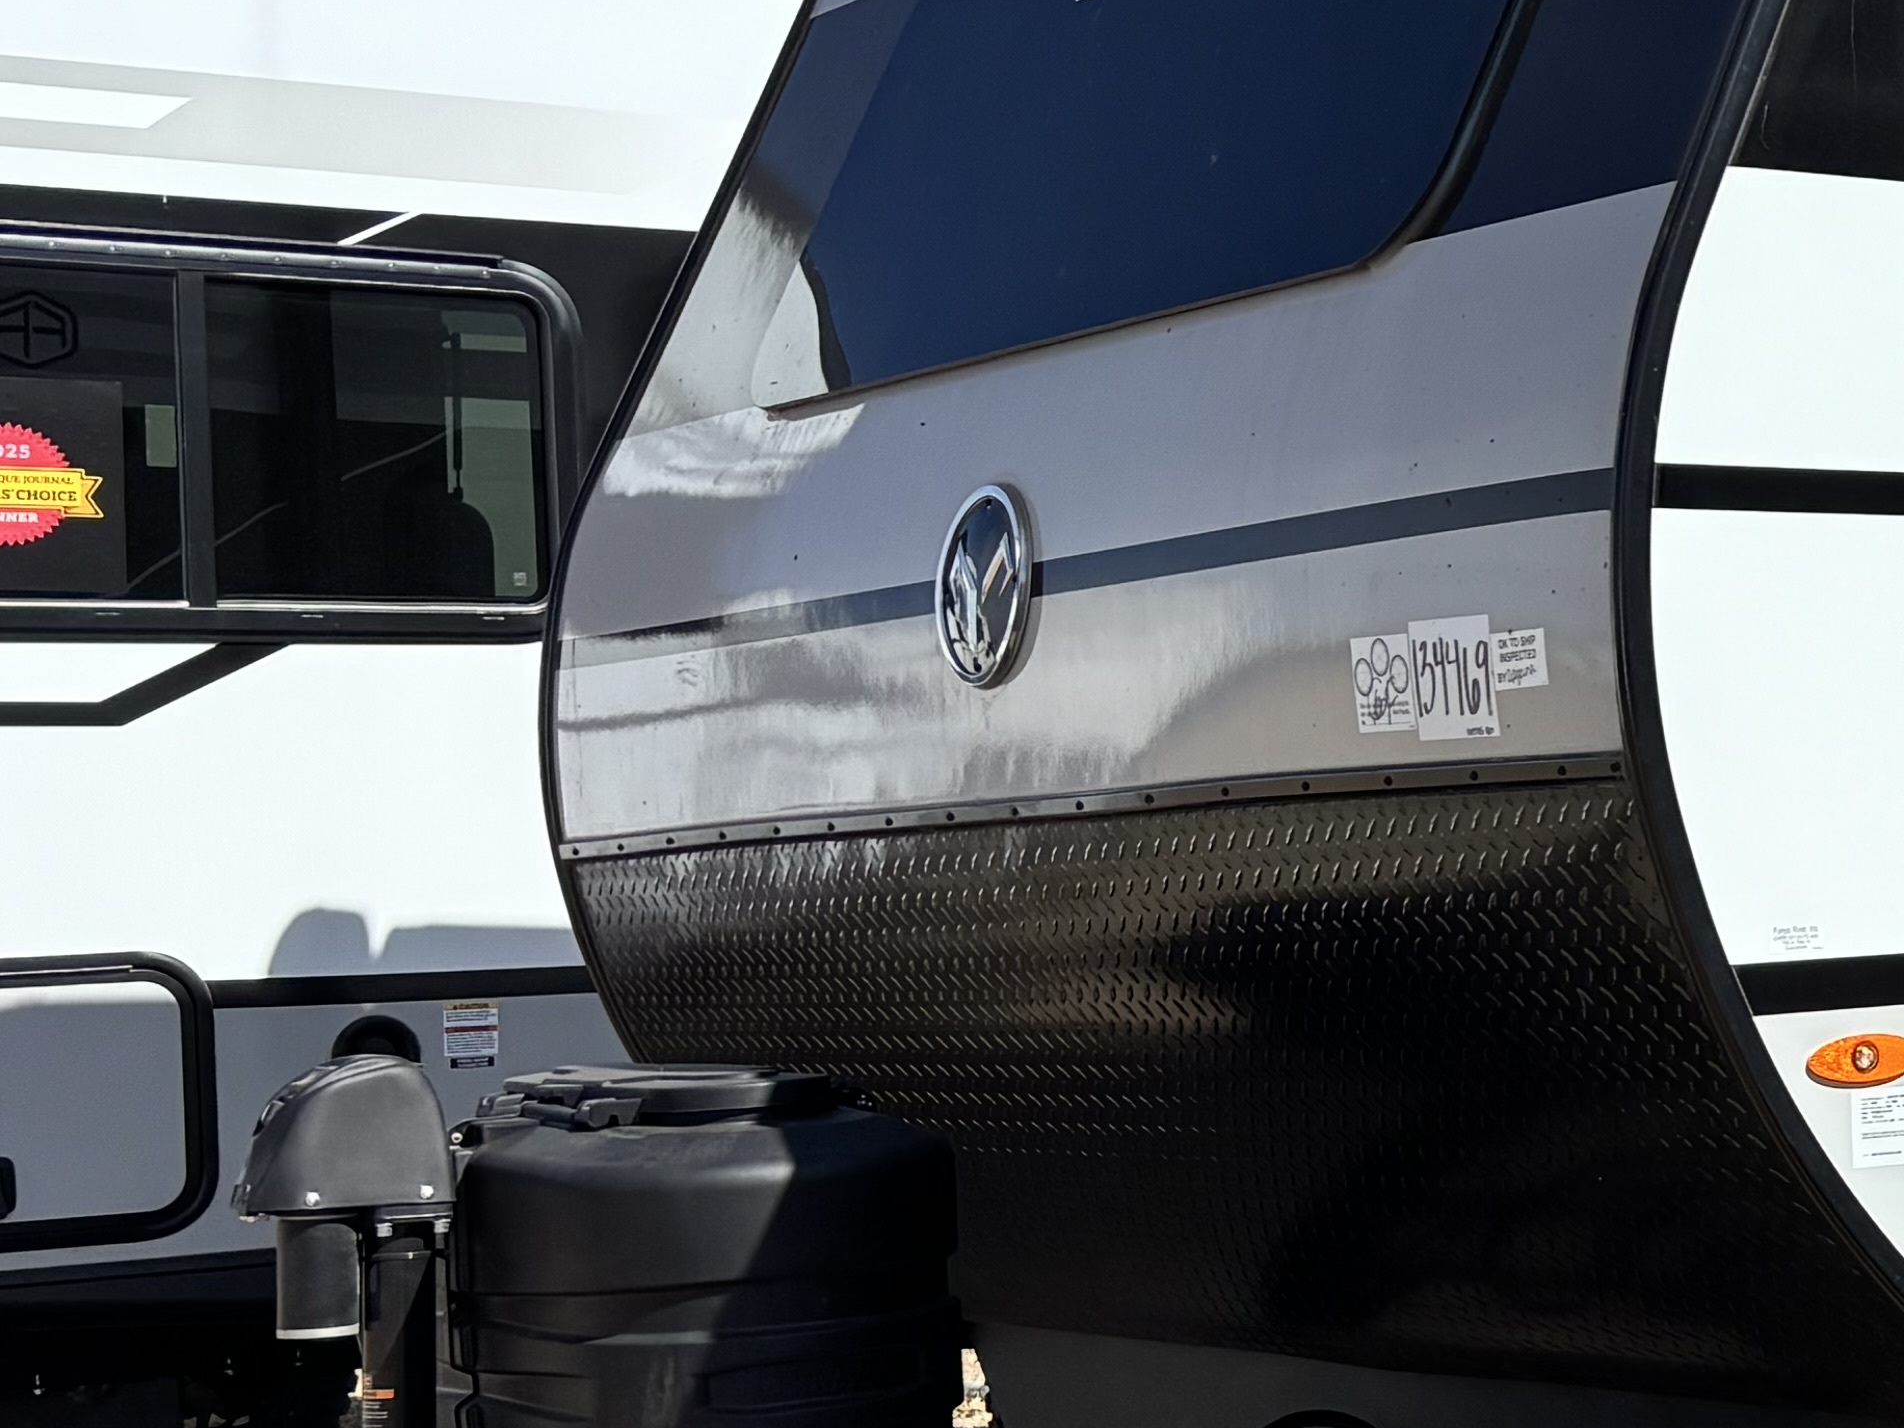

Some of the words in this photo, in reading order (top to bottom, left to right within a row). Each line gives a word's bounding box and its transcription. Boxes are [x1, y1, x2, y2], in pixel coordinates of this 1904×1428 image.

[23, 475, 74, 485] JOURNAL
[16, 489, 77, 502] CHOICE
[1411, 636, 1494, 718] 134469
